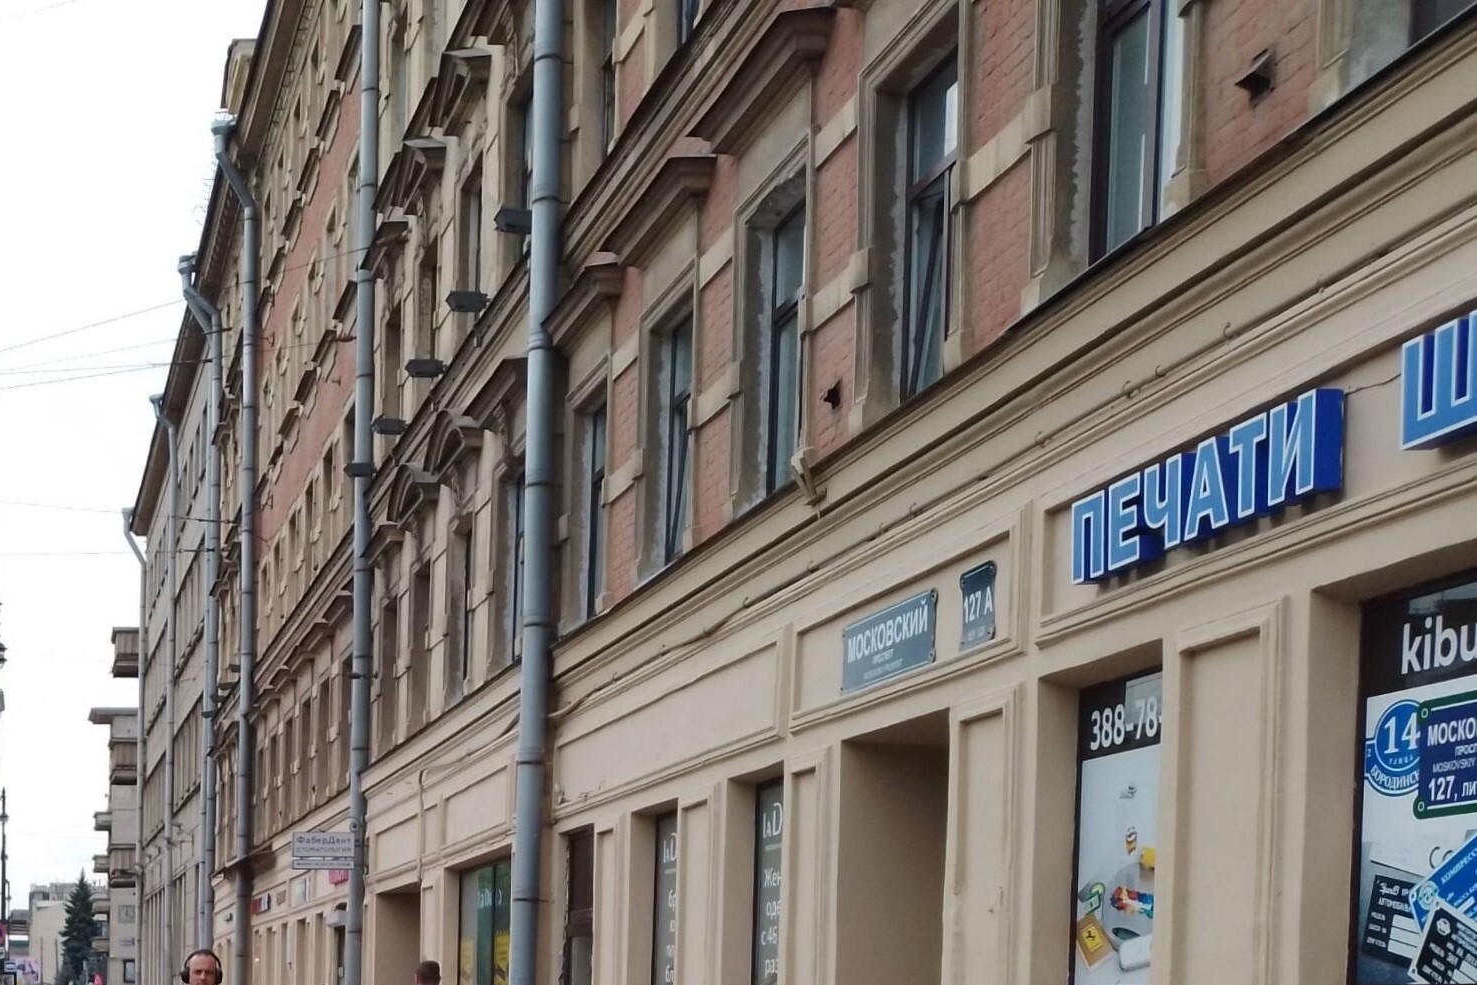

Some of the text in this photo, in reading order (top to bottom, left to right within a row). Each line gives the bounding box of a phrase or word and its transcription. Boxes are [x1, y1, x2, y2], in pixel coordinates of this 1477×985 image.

[1072, 388, 1319, 585] ПЕЧАТИ
[964, 586, 993, 624] 127 А
[847, 599, 928, 664] МОСКОВСКИЙ
[1384, 712, 1420, 754] 14
[1427, 717, 1477, 747] МОСКО
[1428, 775, 1477, 801] 127, ли
